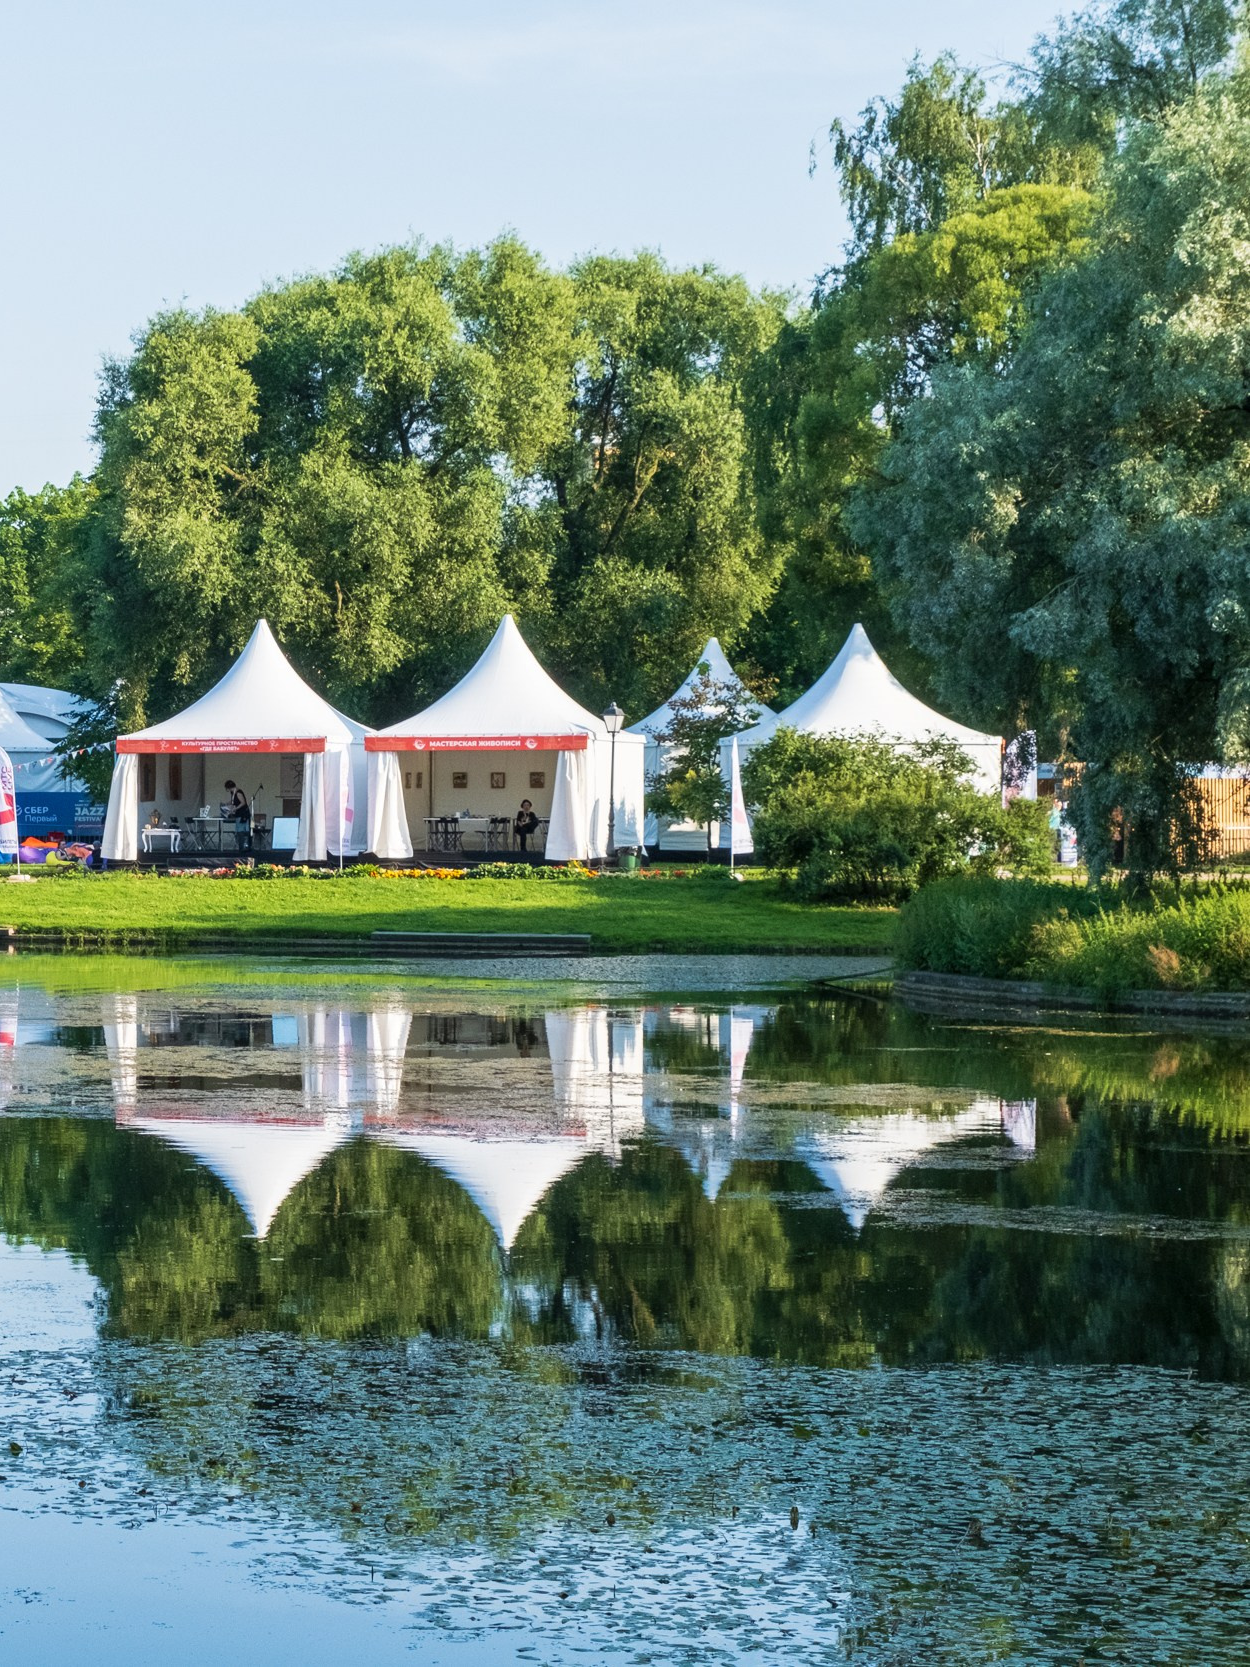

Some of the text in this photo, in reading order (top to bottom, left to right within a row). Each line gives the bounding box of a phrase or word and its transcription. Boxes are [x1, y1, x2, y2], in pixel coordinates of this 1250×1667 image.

[24, 806, 49, 814] СБЕР
[74, 807, 105, 816] JAZZ
[24, 814, 58, 824] Первый
